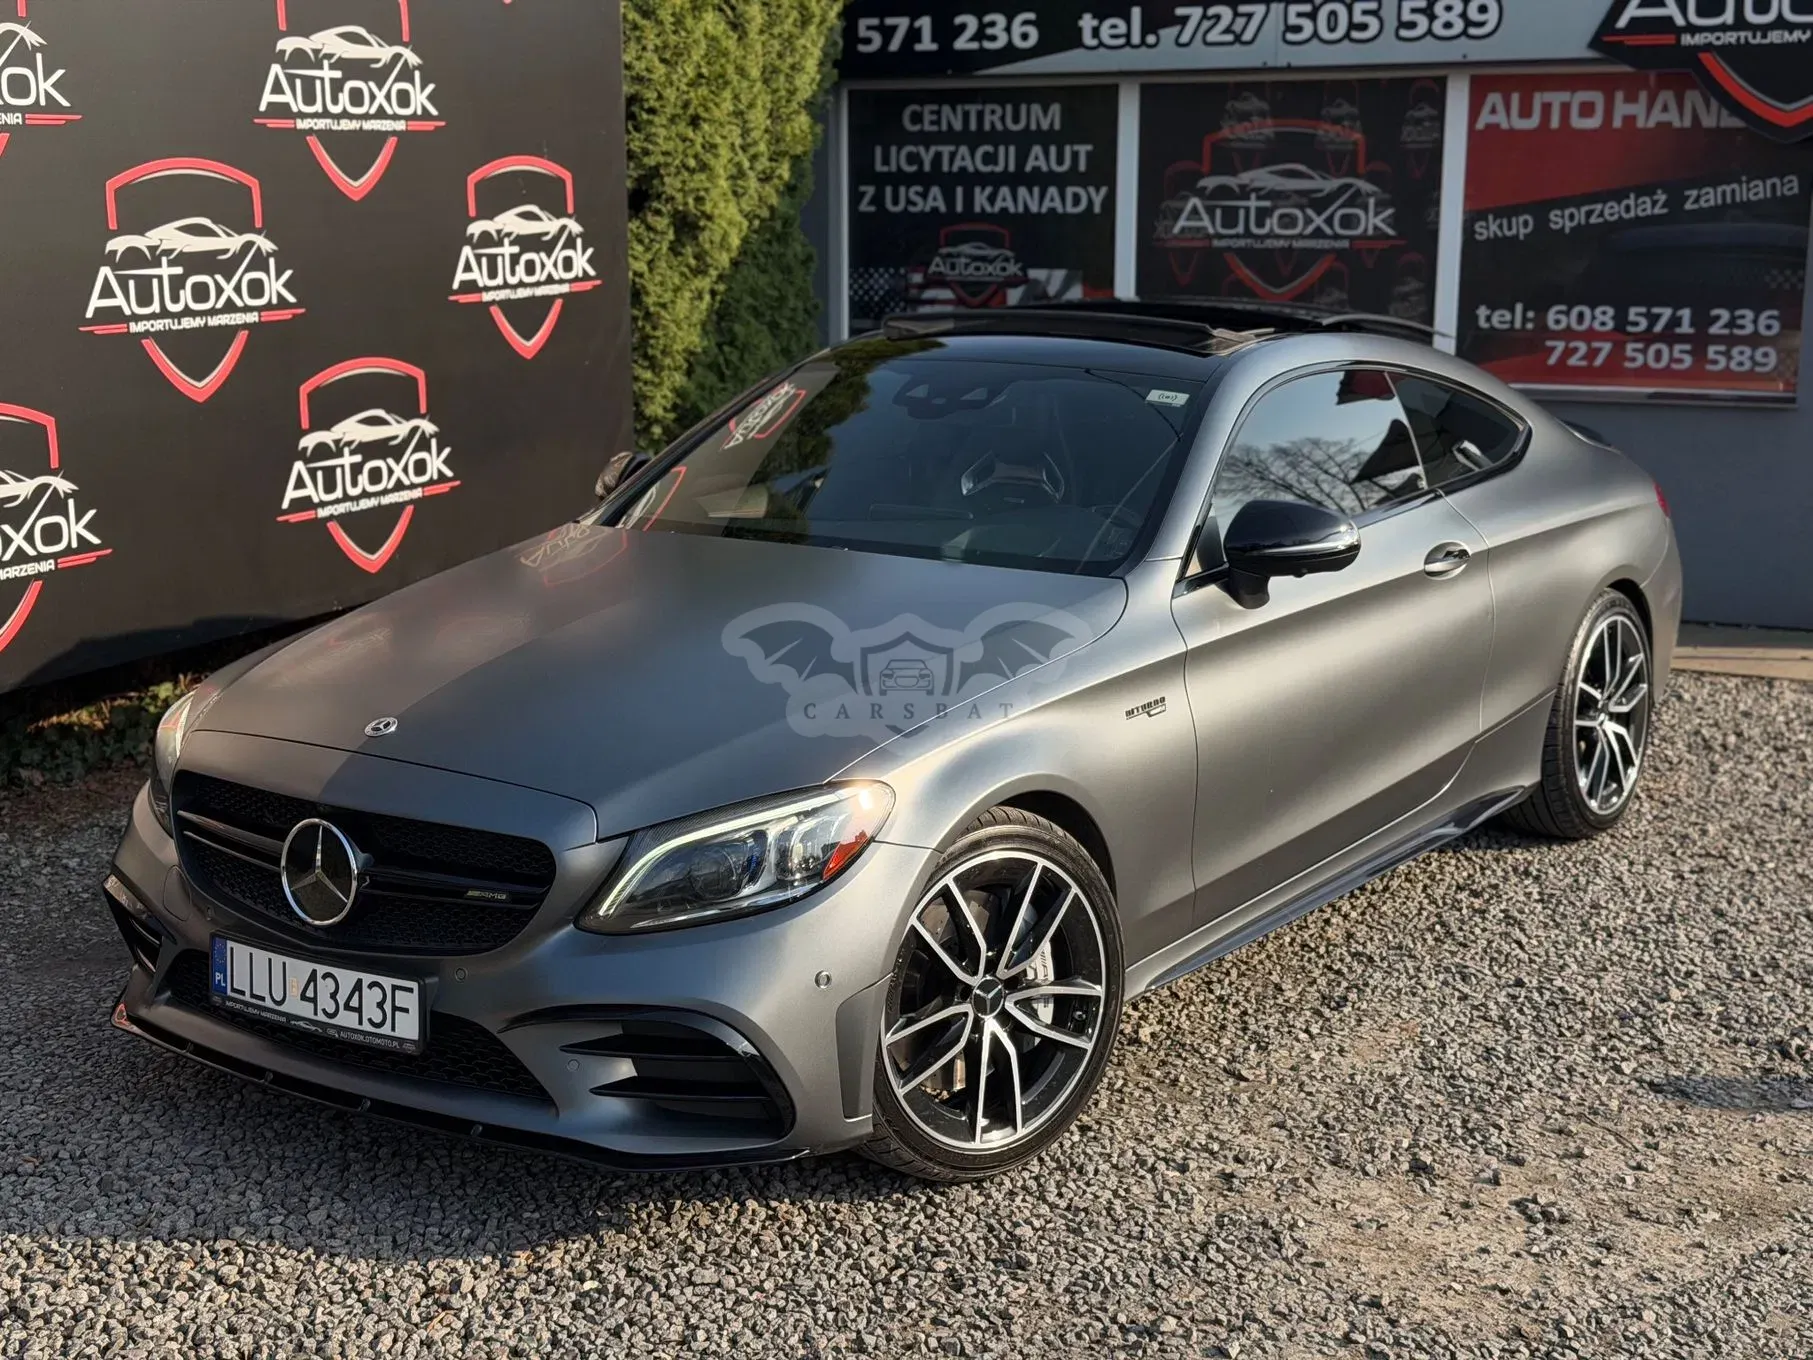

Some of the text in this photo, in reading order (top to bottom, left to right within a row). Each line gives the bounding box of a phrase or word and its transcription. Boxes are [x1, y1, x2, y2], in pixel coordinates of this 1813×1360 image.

[857, 0, 1500, 53] 571 236 tel. 727 505 589
[1680, 29, 1812, 46] IMPORTUJEMY
[258, 60, 439, 116] Autoxok
[296, 118, 361, 130] IMPORTUJEMY
[902, 103, 1061, 132] CENTRUM
[1475, 90, 1605, 131] AUTO
[874, 144, 1093, 173] LICYTACJI AUT
[858, 186, 1109, 215] Z USA I KANADY
[1171, 192, 1397, 236] Autoxok
[1474, 174, 1799, 241] skup sprzedaż zamiana
[452, 237, 597, 290] Autoxok
[85, 256, 297, 318] Autoxok
[129, 312, 259, 333] IMPORTUJEMY MARZENIA
[1476, 302, 1780, 336] tel: 608 571 236
[1544, 341, 1777, 372] 727 505 589
[281, 438, 454, 510] Autoxok
[214, 972, 226, 987] PL
[229, 946, 415, 1033] LLU 4343F
